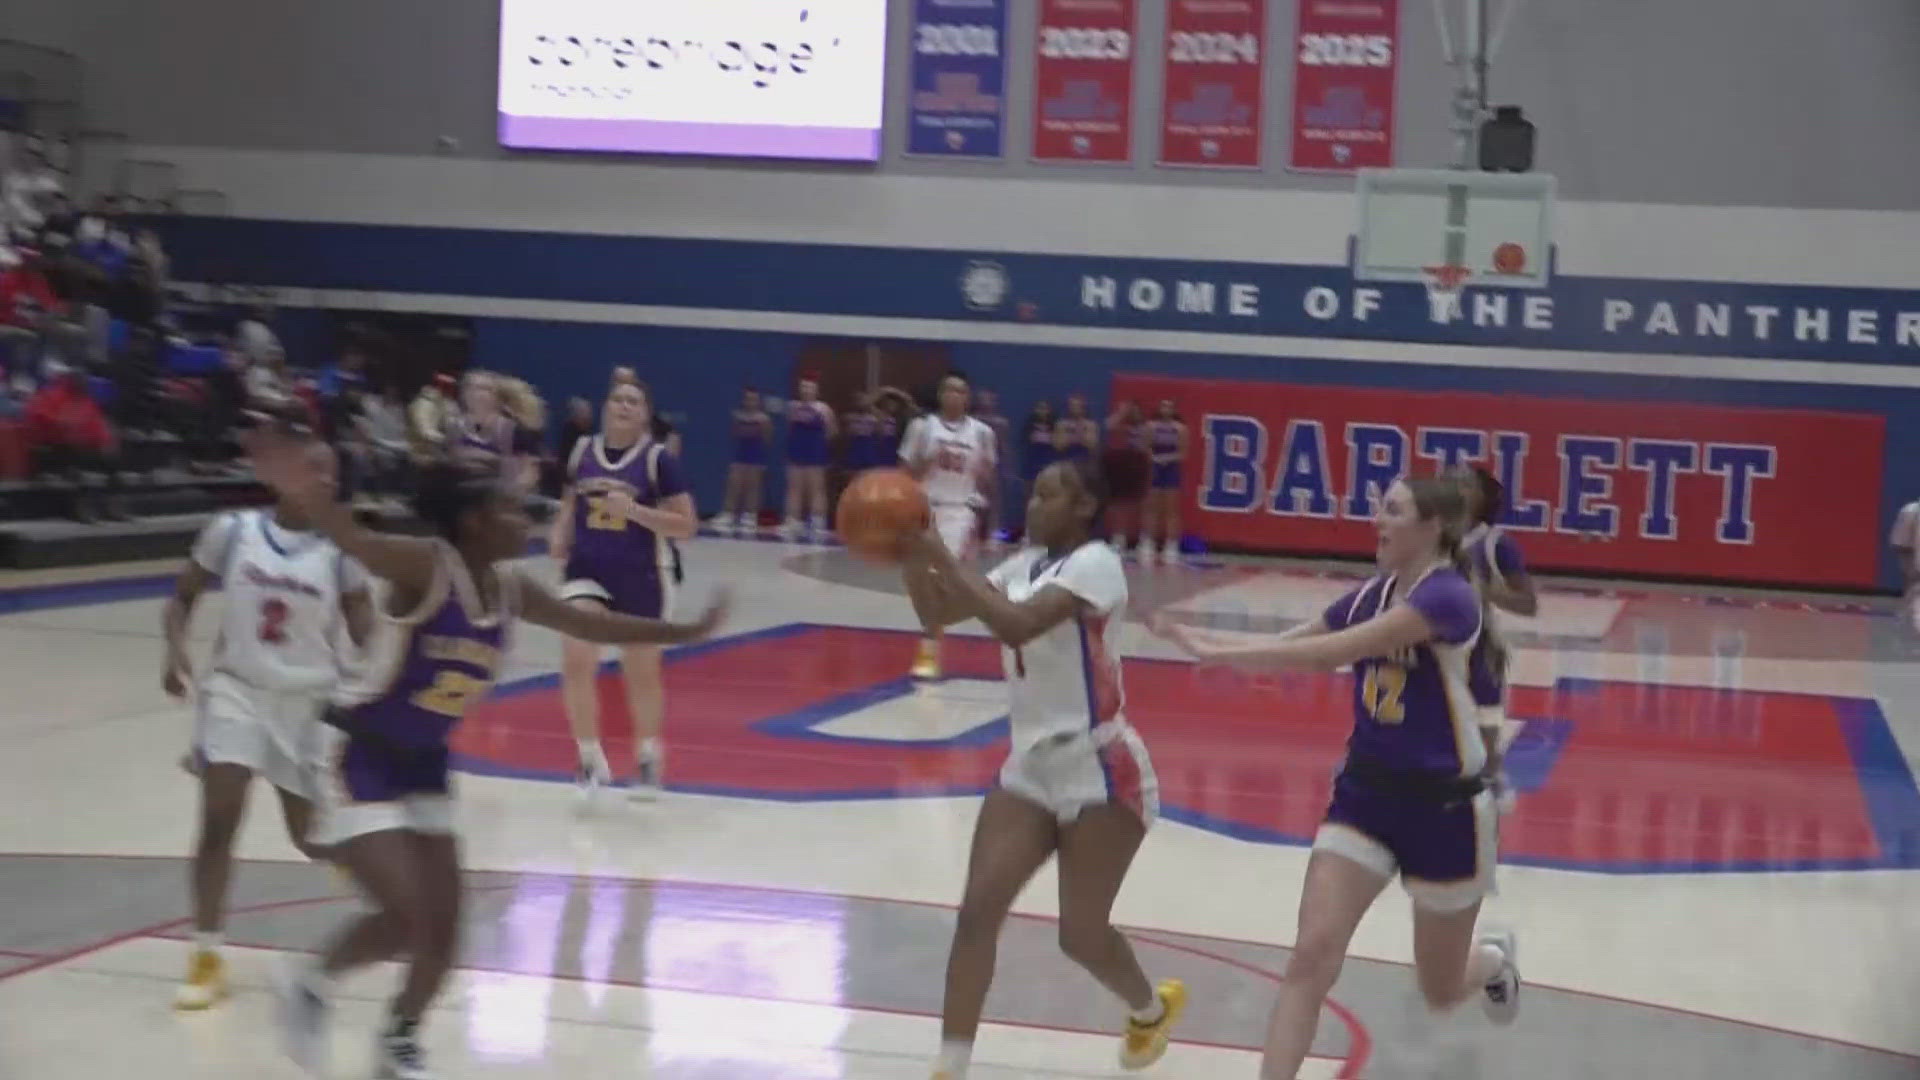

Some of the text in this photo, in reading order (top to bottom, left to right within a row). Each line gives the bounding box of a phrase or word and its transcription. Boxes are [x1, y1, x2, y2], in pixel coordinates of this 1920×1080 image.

[1038, 27, 1130, 59] 2023
[1169, 31, 1259, 64] 2024
[1301, 33, 1392, 66] 2025
[1081, 273, 1260, 316] HOME
[1303, 286, 1383, 321] OF
[1428, 290, 1554, 330] THE
[1199, 413, 1778, 545] BARTLETT
[258, 597, 290, 643] 2
